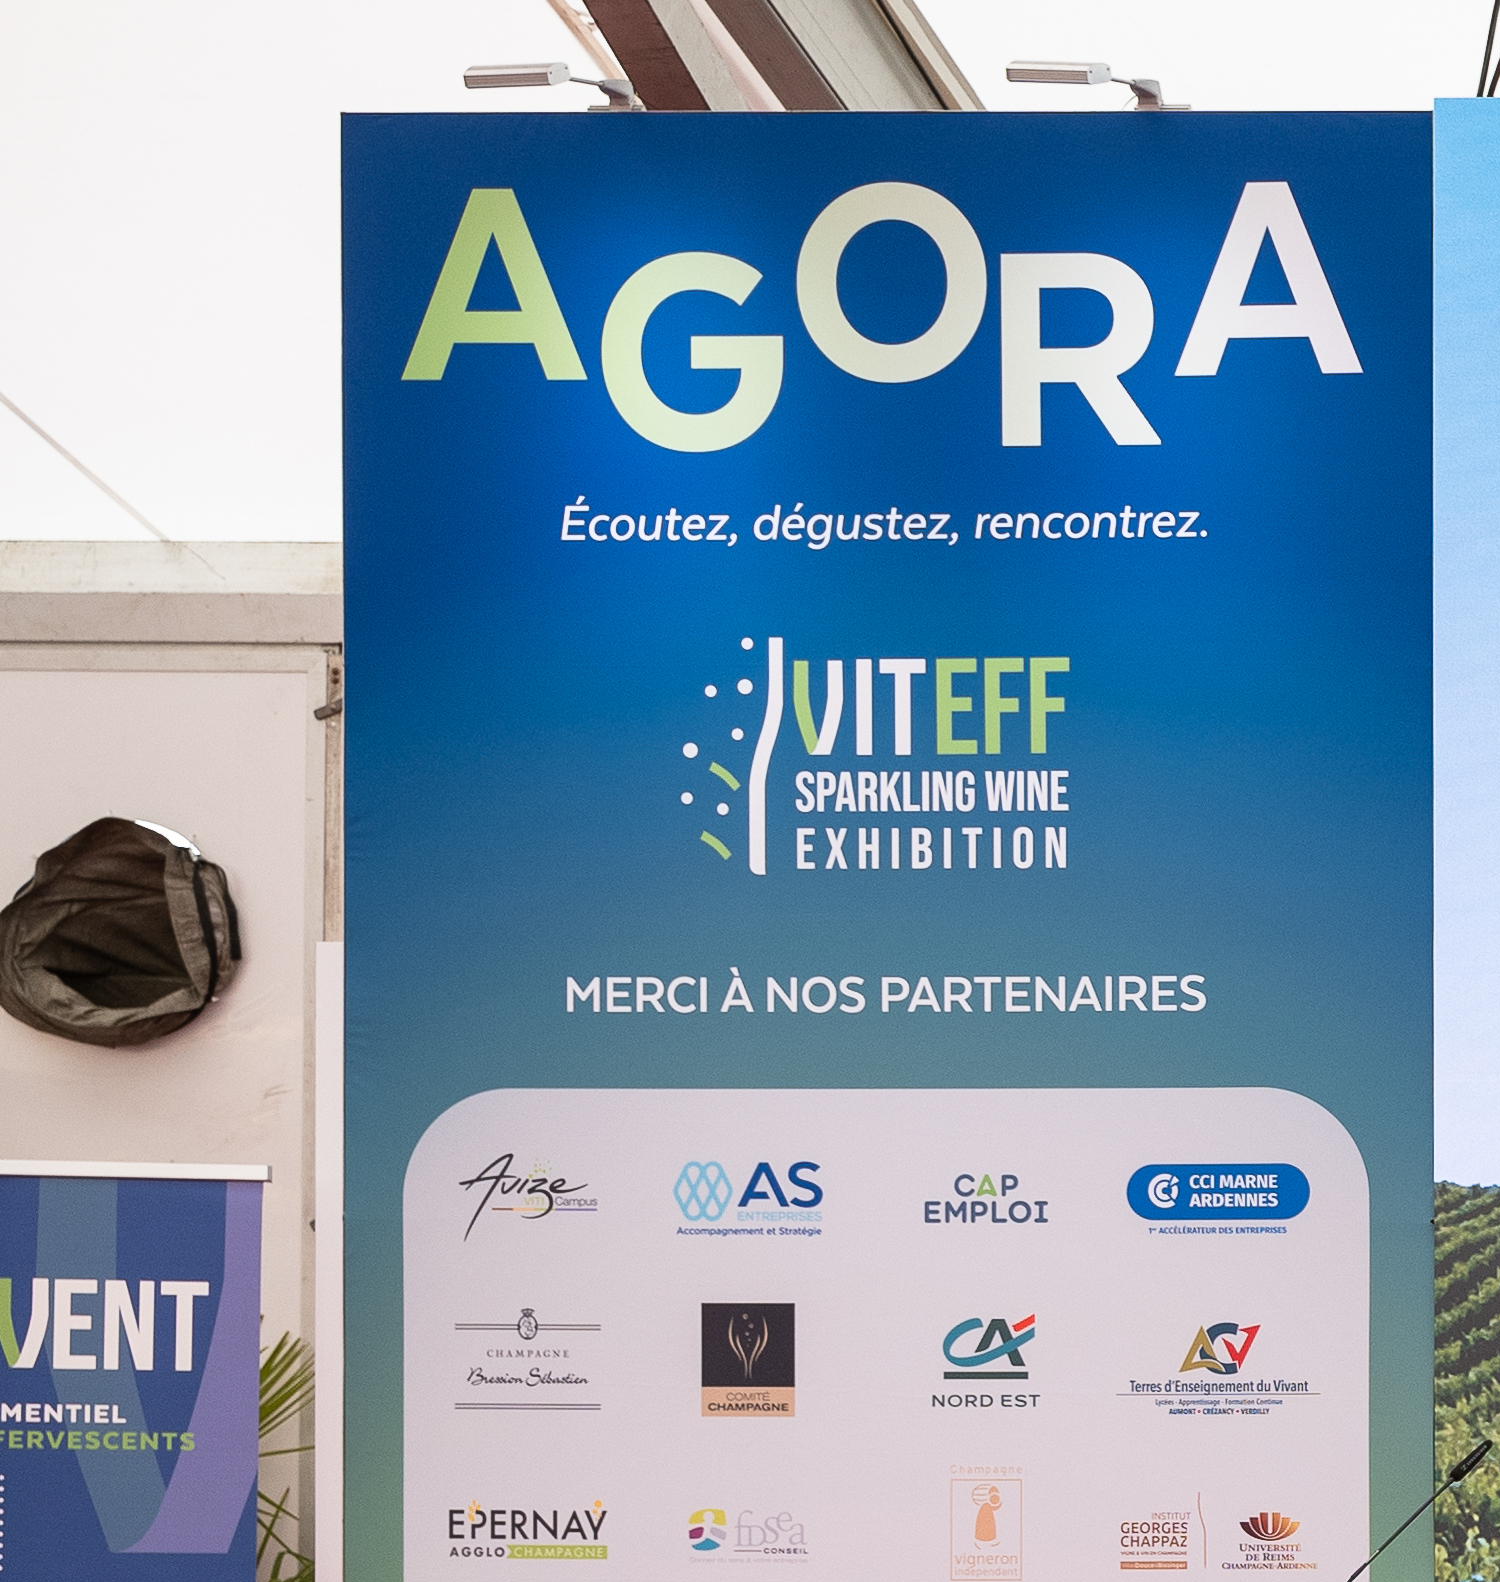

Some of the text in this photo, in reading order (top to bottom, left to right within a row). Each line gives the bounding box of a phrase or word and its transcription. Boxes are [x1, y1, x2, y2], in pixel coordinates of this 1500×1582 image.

[402, 182, 1363, 452] AGORA
[561, 496, 1207, 549] Écoutez, dégustez, rencontrez.
[793, 657, 1069, 755] VITEFF
[796, 771, 1069, 812] SPARKLING WINE
[797, 827, 1066, 869] EXHIBITION
[567, 967, 1206, 1013] MERCI À NOS PARTENAIRES
[738, 1161, 823, 1208] AS
[954, 1174, 1018, 1197] CAP
[925, 1201, 1048, 1223] EMPLOI
[932, 1395, 1040, 1407] NORD EST
